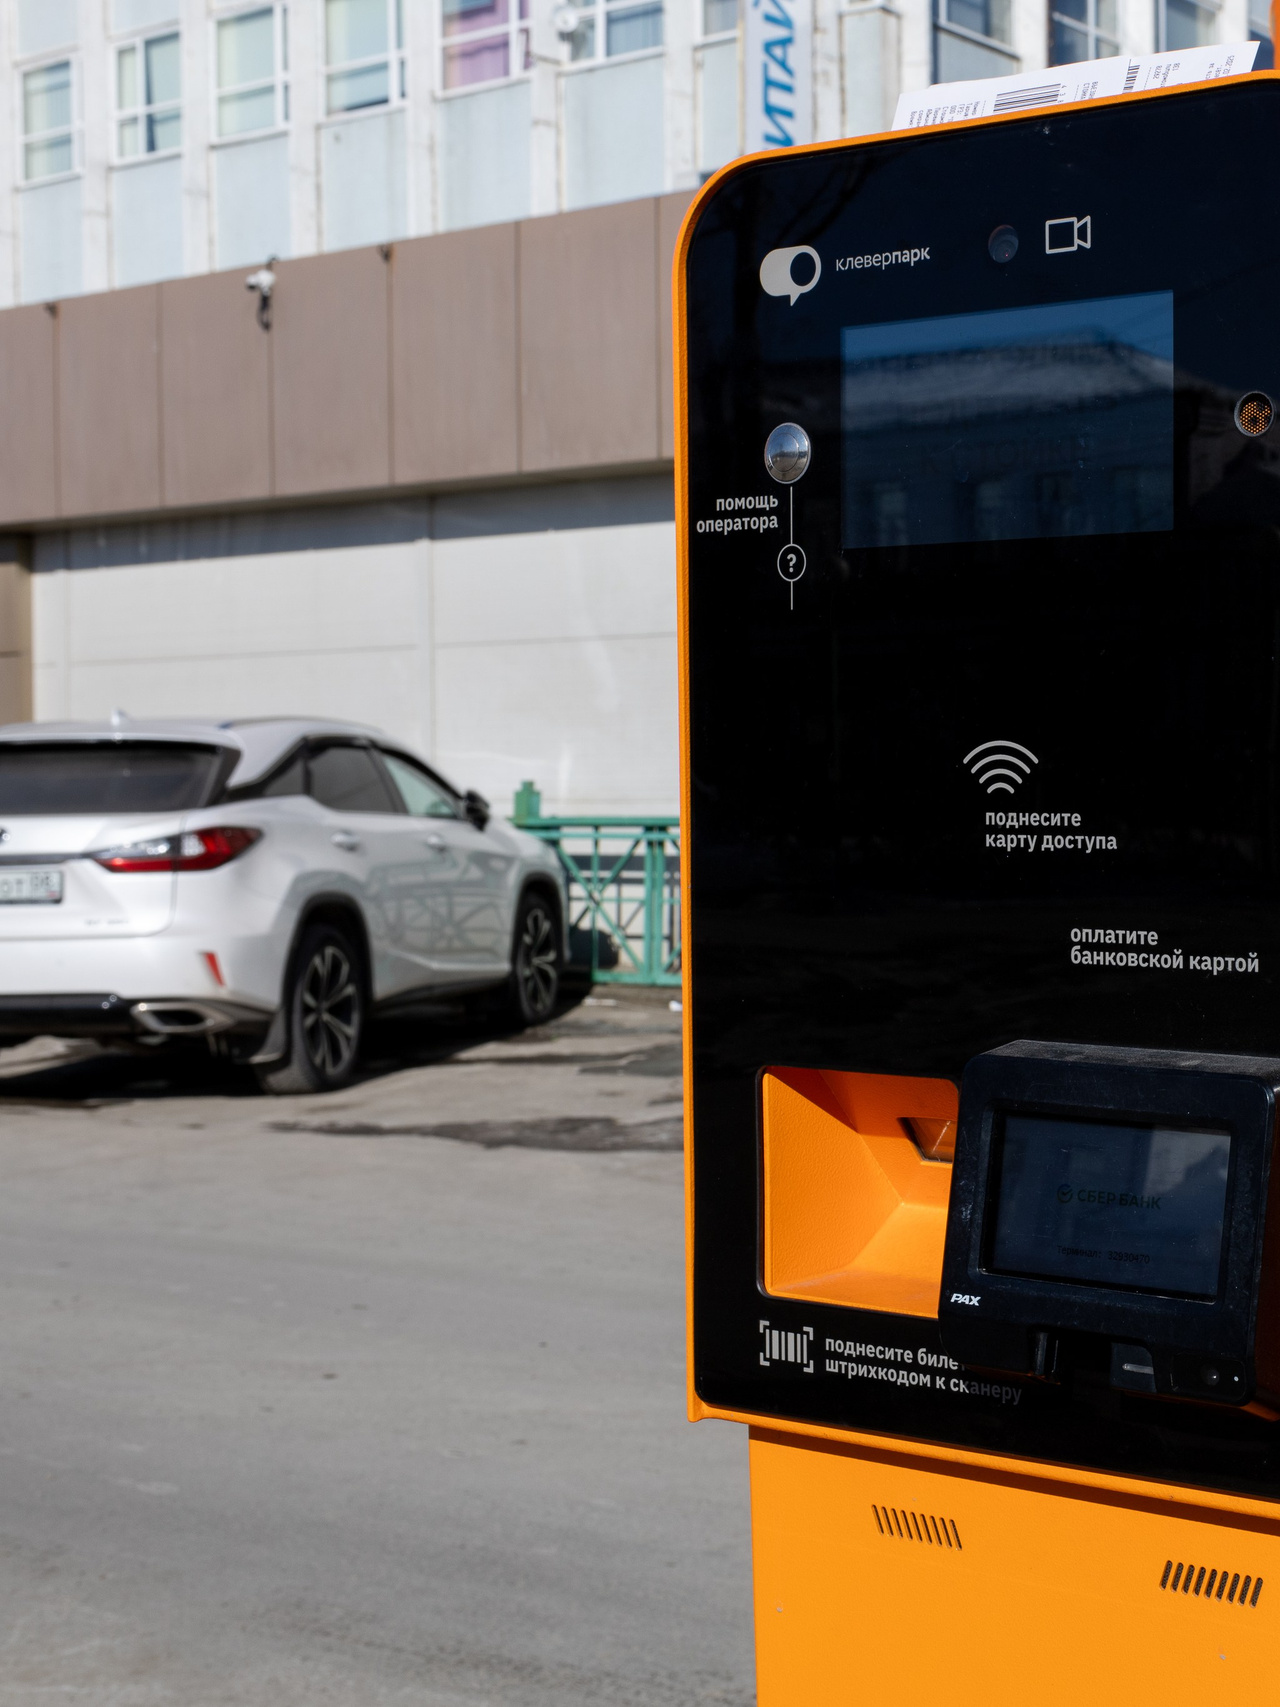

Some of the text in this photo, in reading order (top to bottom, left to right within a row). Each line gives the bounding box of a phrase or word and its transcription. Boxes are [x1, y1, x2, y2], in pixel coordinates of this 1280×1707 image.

[753, 0, 794, 148] ИТАЙ
[836, 248, 931, 272] клеверпарк
[716, 495, 779, 514] помощь
[696, 514, 779, 536] оператора
[985, 811, 1082, 829] поднесите
[985, 833, 1118, 854] карту доступа
[1070, 927, 1159, 947] оплатите
[1070, 945, 1260, 977] банковской картой
[1077, 1189, 1161, 1210] СБЕР БАНК
[1057, 1245, 1102, 1259] Терминал:
[950, 1293, 982, 1307] PAX
[825, 1338, 967, 1371] поднесите биле
[825, 1358, 1023, 1405] штрихкодом к сканеру
